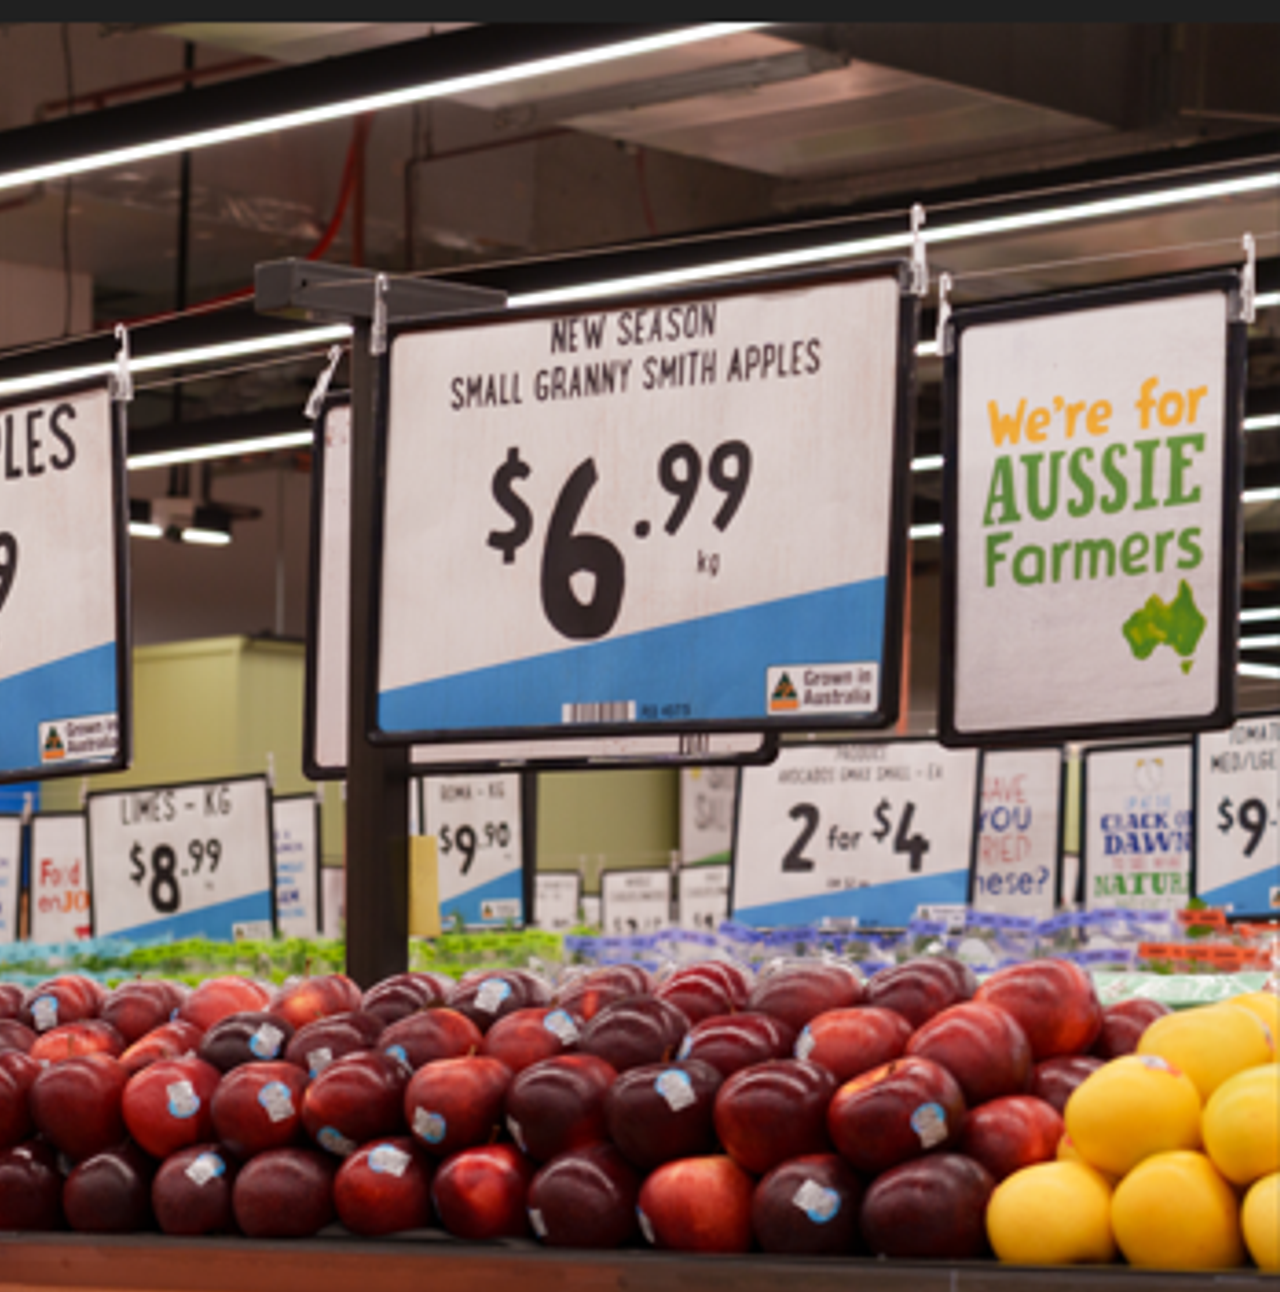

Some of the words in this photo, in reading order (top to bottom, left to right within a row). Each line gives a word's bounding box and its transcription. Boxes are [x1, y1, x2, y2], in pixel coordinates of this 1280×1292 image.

[551, 317, 605, 355] NEW
[617, 303, 716, 345] SEASON
[451, 376, 521, 410] SMALL
[533, 359, 632, 401] GRANNY
[642, 350, 717, 390] SMITH
[727, 339, 821, 383] APPLES
[987, 396, 1113, 447] We're
[1134, 375, 1208, 430] for
[982, 432, 1205, 527] AUSSIE
[486, 440, 753, 641] $6.99
[697, 551, 719, 576] kg
[985, 527, 1204, 588] Farmers
[121, 791, 176, 825] LIMES
[203, 786, 231, 816] KG
[781, 802, 819, 873] 2
[828, 825, 862, 849] for
[872, 797, 929, 872] $4
[129, 839, 222, 913] $8.99
